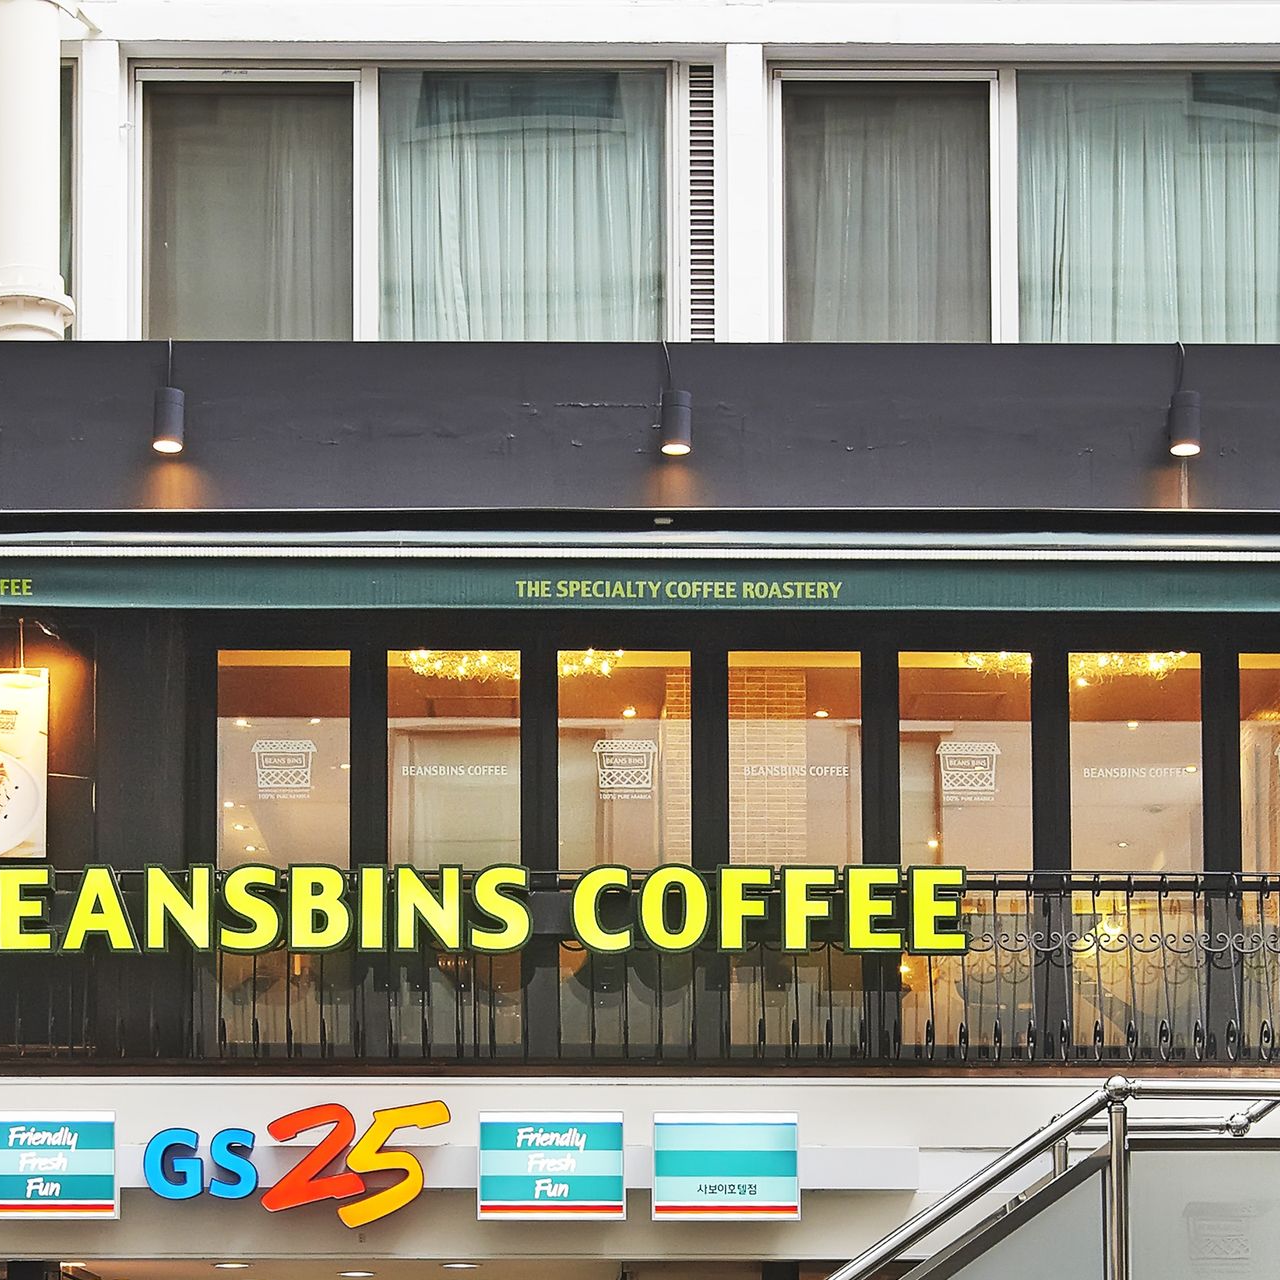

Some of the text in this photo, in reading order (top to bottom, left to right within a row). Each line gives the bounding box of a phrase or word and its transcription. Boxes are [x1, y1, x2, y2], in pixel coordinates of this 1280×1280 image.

[516, 580, 843, 599] THE SPECIALTY COFFEE ROASTERY
[402, 766, 508, 776] BEANSBINS COFFEE
[744, 766, 849, 777] BEANSBINS COFFEE
[1083, 767, 1146, 778] BEANSBINS
[571, 865, 966, 953] COFFEE
[8, 1126, 79, 1152] Friendly
[516, 1127, 587, 1152] Friendly
[19, 1152, 67, 1172] Fresh
[143, 1099, 451, 1229] GS25
[527, 1153, 576, 1173] Fresh
[26, 1177, 62, 1198] Fun
[534, 1178, 569, 1199] Fun
[696, 1184, 758, 1196] 사보이호텔점
